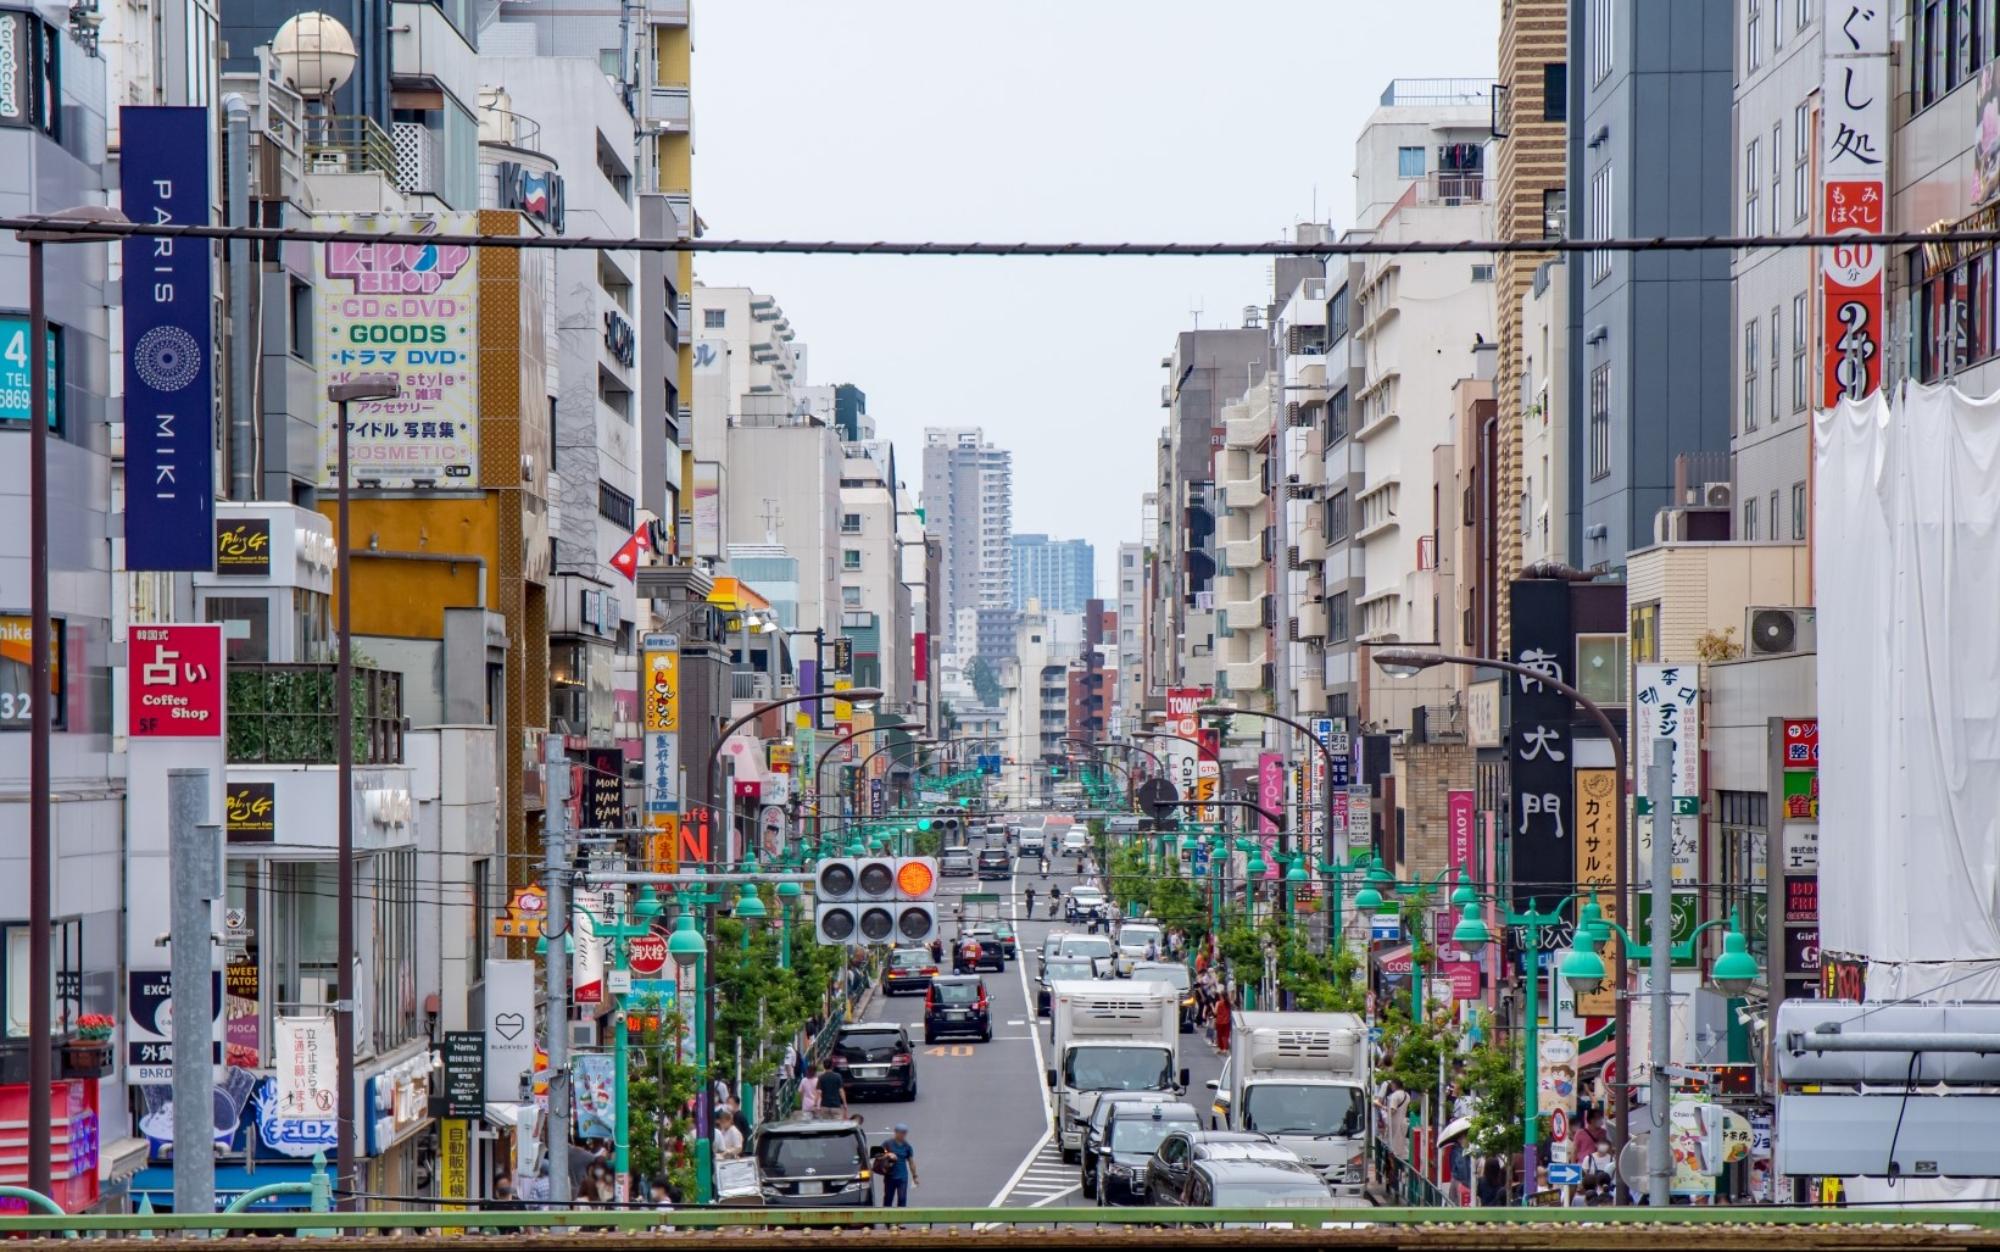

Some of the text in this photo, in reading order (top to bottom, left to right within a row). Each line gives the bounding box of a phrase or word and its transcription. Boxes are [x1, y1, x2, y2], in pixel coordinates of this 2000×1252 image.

[1829, 5, 1882, 164] ぐし処
[1831, 207, 1877, 224] ほぐし
[153, 179, 173, 303] PARIS
[1833, 240, 1873, 270] 60
[359, 273, 442, 292] SHOP
[1847, 268, 1861, 281] 分
[342, 300, 456, 317] CD & DVD
[350, 324, 446, 343] GOODS
[5, 330, 27, 368] 4
[341, 350, 456, 365] ドラマ DVD
[6, 373, 31, 386] TEL
[406, 372, 454, 387] style
[358, 402, 434, 413] アクセサリー
[345, 422, 455, 438] アイドル 写真集
[156, 414, 175, 499] MIKI
[136, 629, 169, 641] 韓国式
[143, 644, 207, 686] 占い
[142, 694, 188, 706] Coffee
[171, 706, 209, 721] Shop
[1519, 648, 1565, 838] 南大門
[595, 778, 618, 788] MON
[595, 792, 619, 805] NAN
[595, 806, 620, 820] GAM
[1457, 808, 1466, 864] LOVELY
[1585, 799, 1600, 871] カイサル
[680, 825, 708, 863] N
[630, 944, 665, 961] 消火栓
[454, 1043, 477, 1052] Namu
[924, 1046, 975, 1057] 40
[294, 1028, 306, 1113] ご通行願います
[306, 1028, 318, 1099] 立ち止まらず
[449, 1128, 464, 1197] 自動販売機
